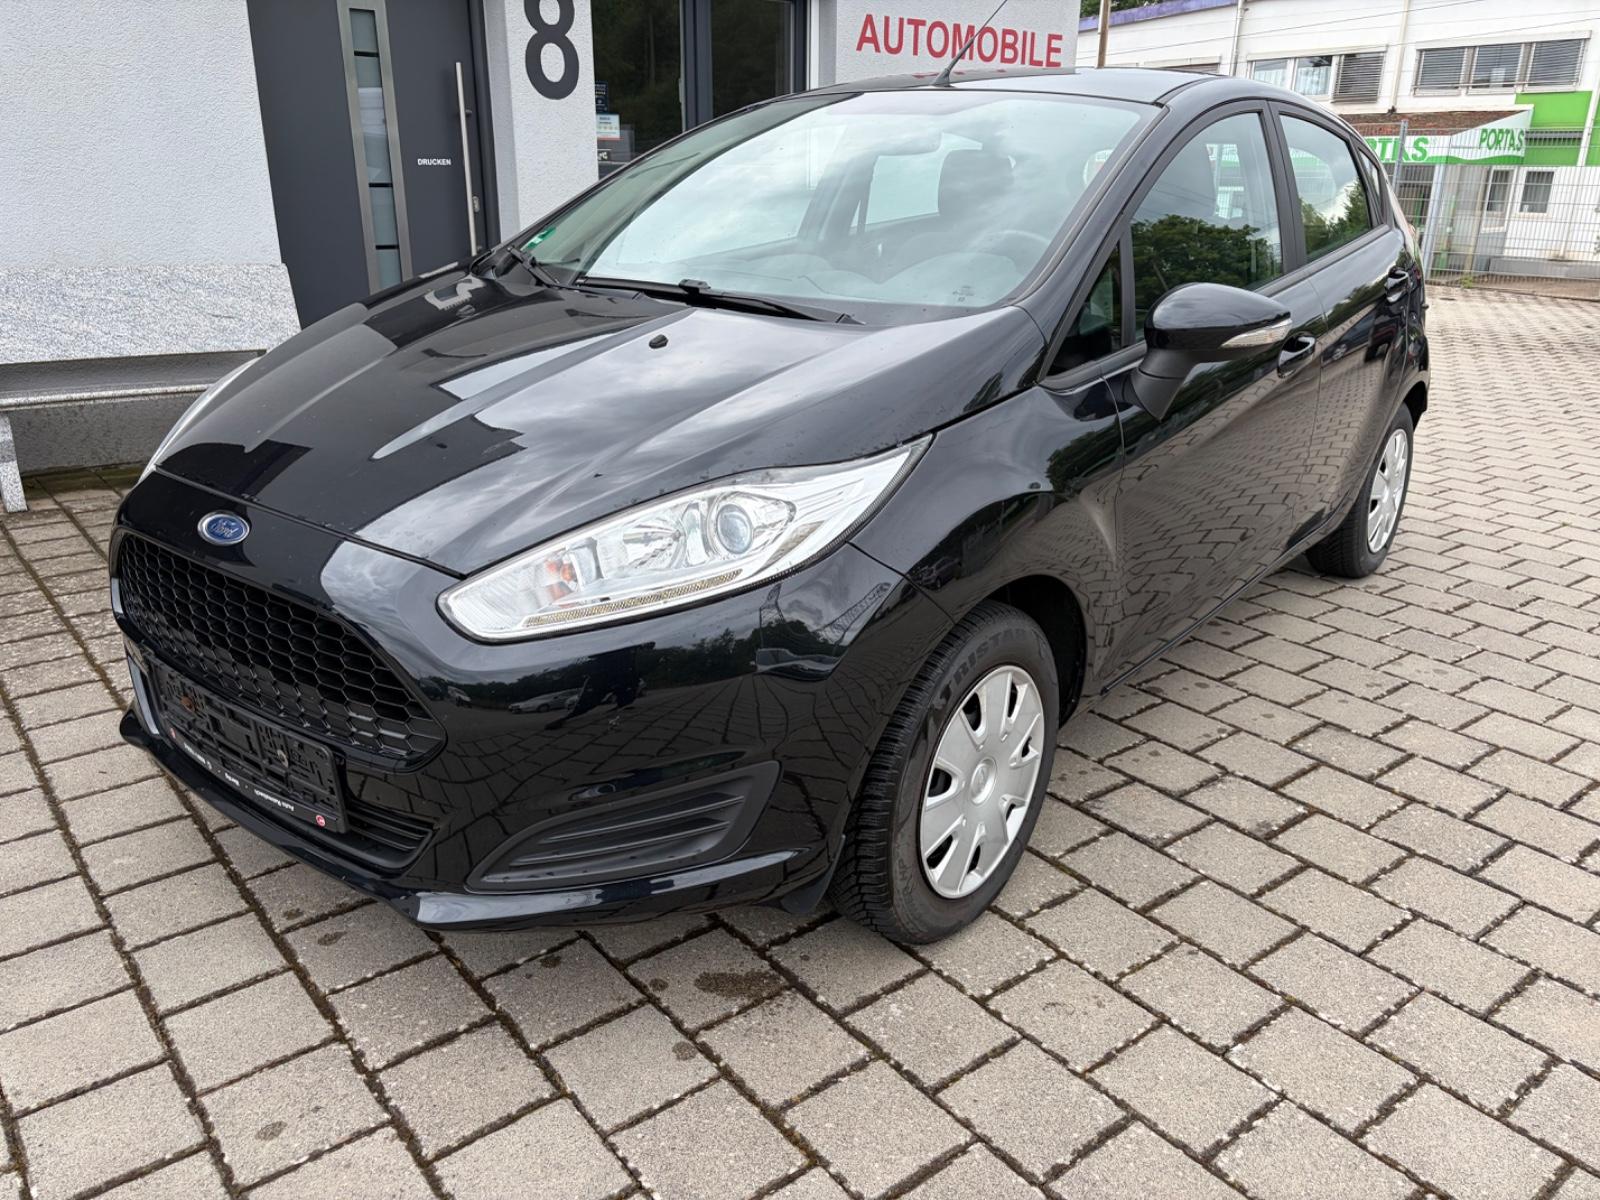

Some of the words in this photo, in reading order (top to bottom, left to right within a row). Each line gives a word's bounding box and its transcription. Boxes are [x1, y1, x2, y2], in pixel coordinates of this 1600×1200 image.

[524, 0, 579, 100] 8
[856, 13, 1063, 68] AUTOMOBILE
[1479, 128, 1525, 152] PORTAS
